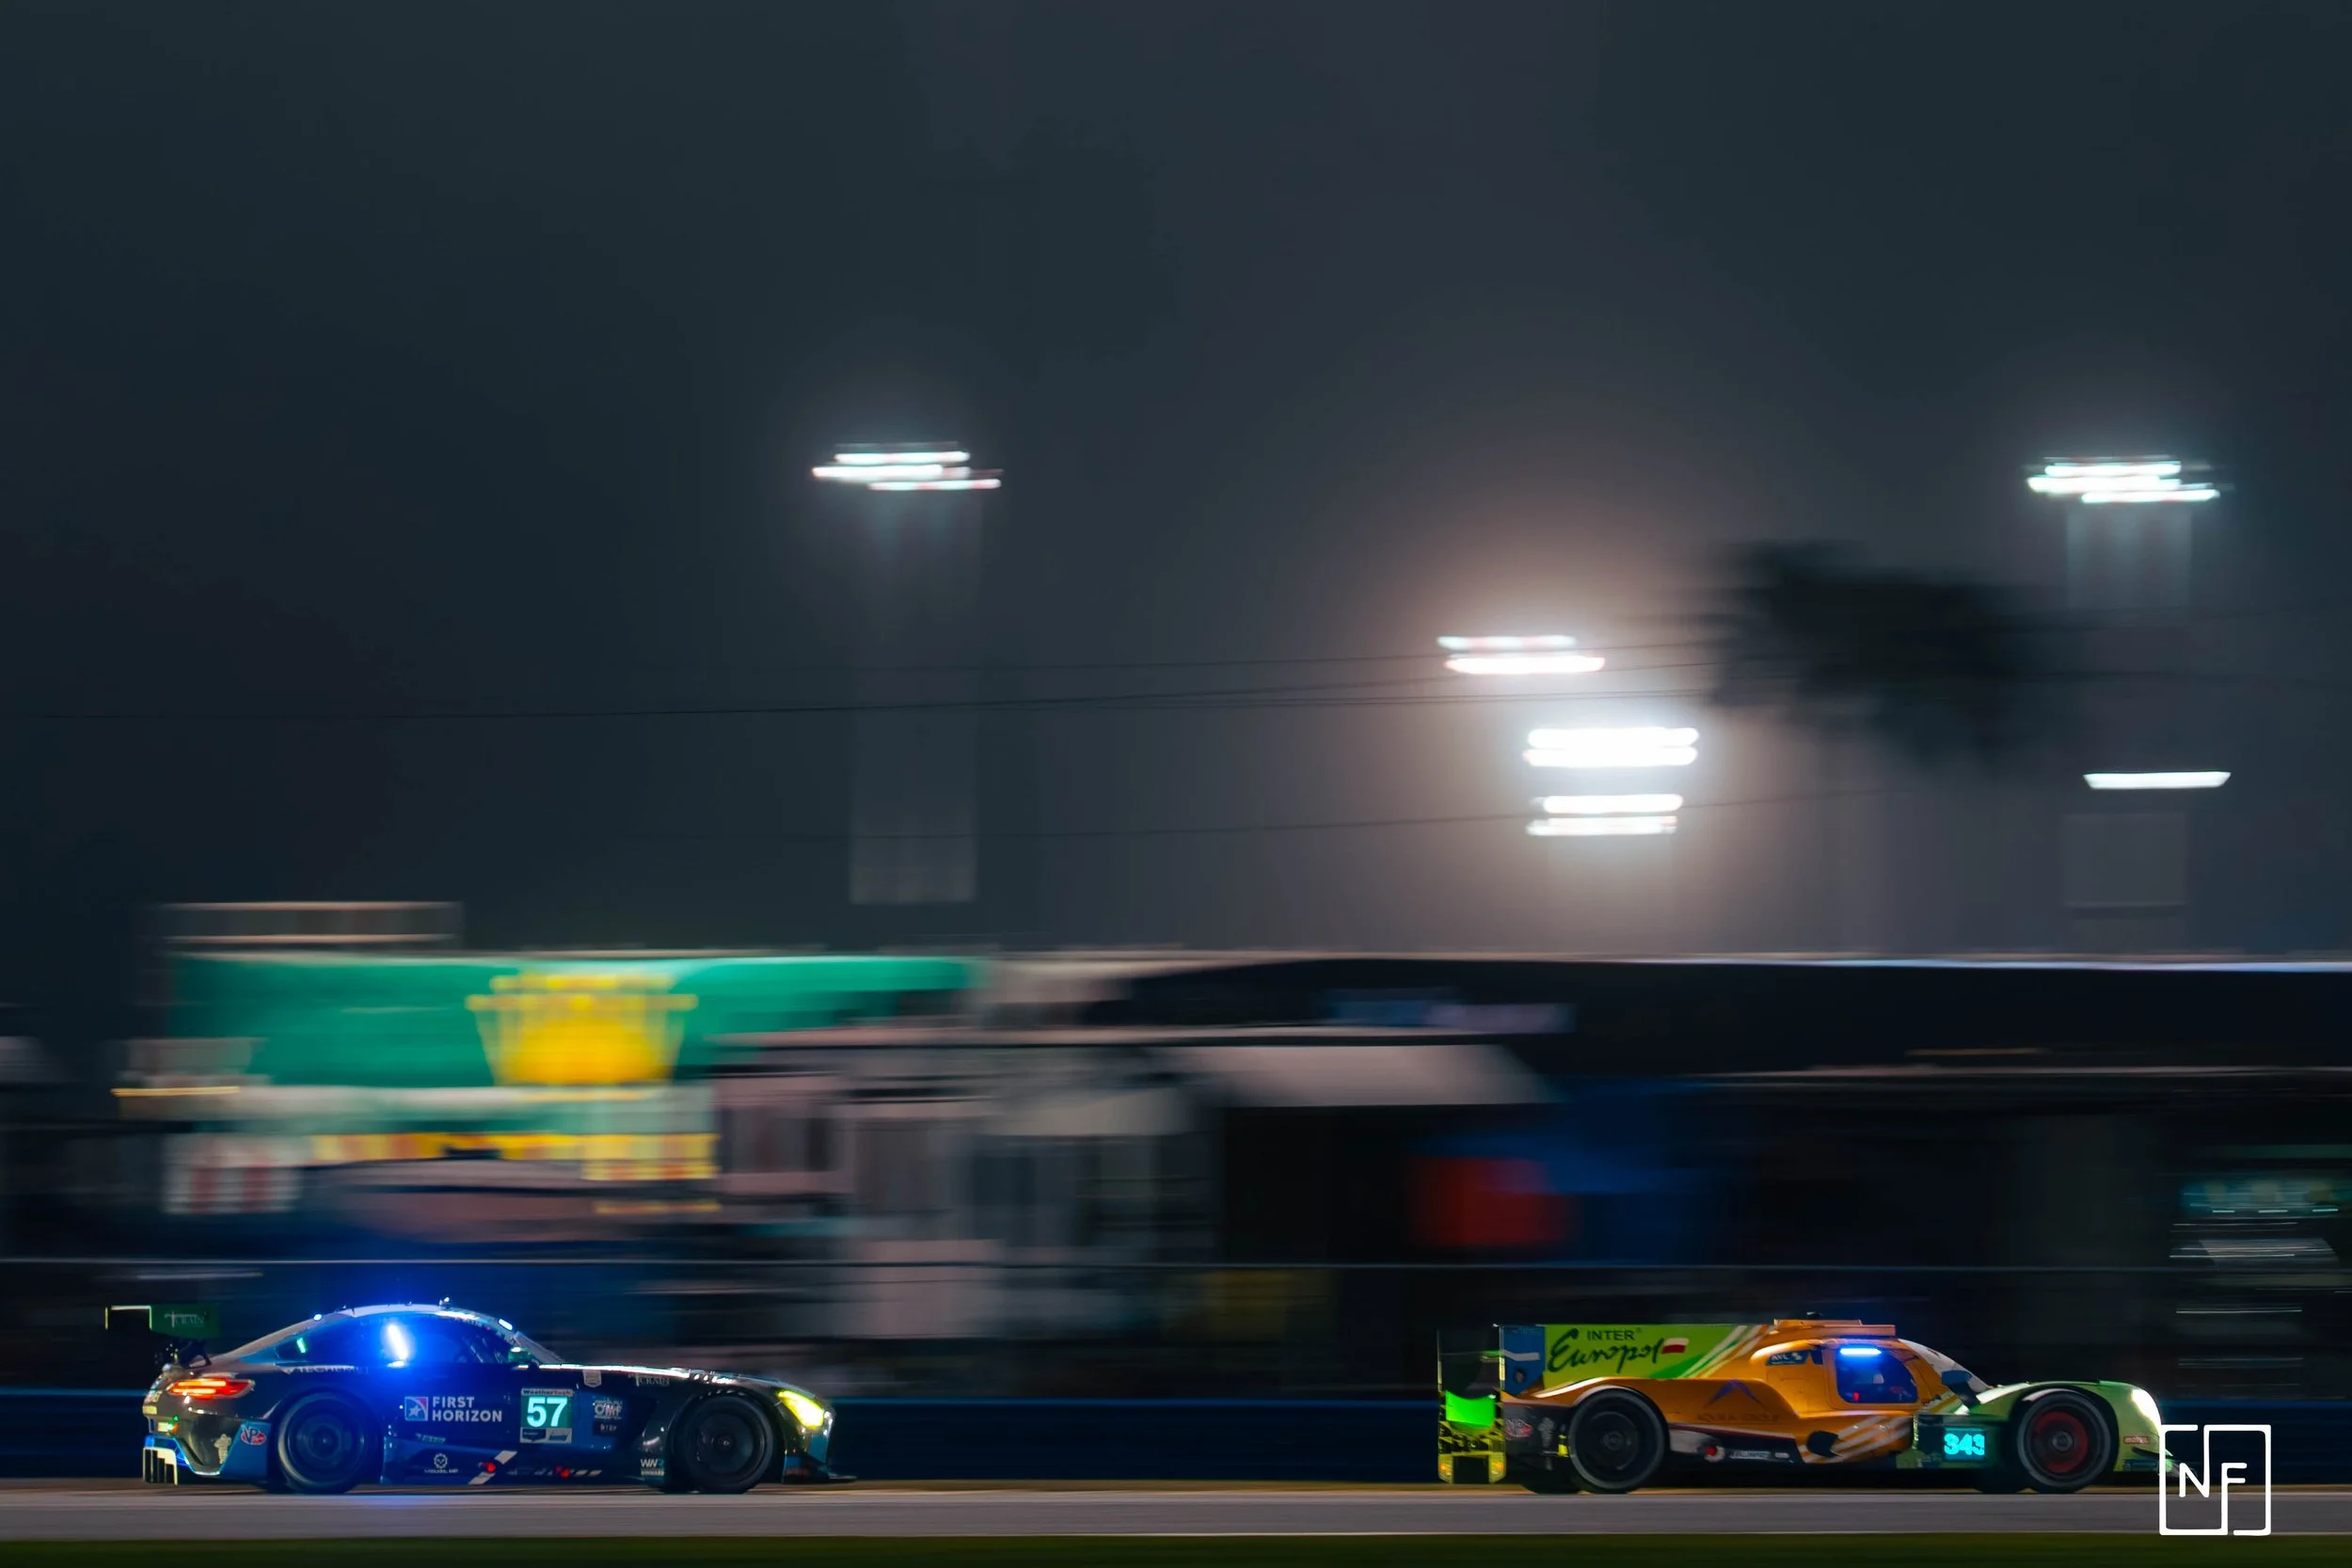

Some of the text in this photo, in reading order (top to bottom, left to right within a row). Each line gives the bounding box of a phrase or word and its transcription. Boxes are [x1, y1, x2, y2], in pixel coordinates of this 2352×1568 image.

[1586, 1329, 1635, 1341] INTER
[1548, 1327, 1664, 1373] Europol
[432, 1396, 475, 1408] FIRST
[432, 1409, 502, 1422] HORIZON
[527, 1396, 568, 1428] 57
